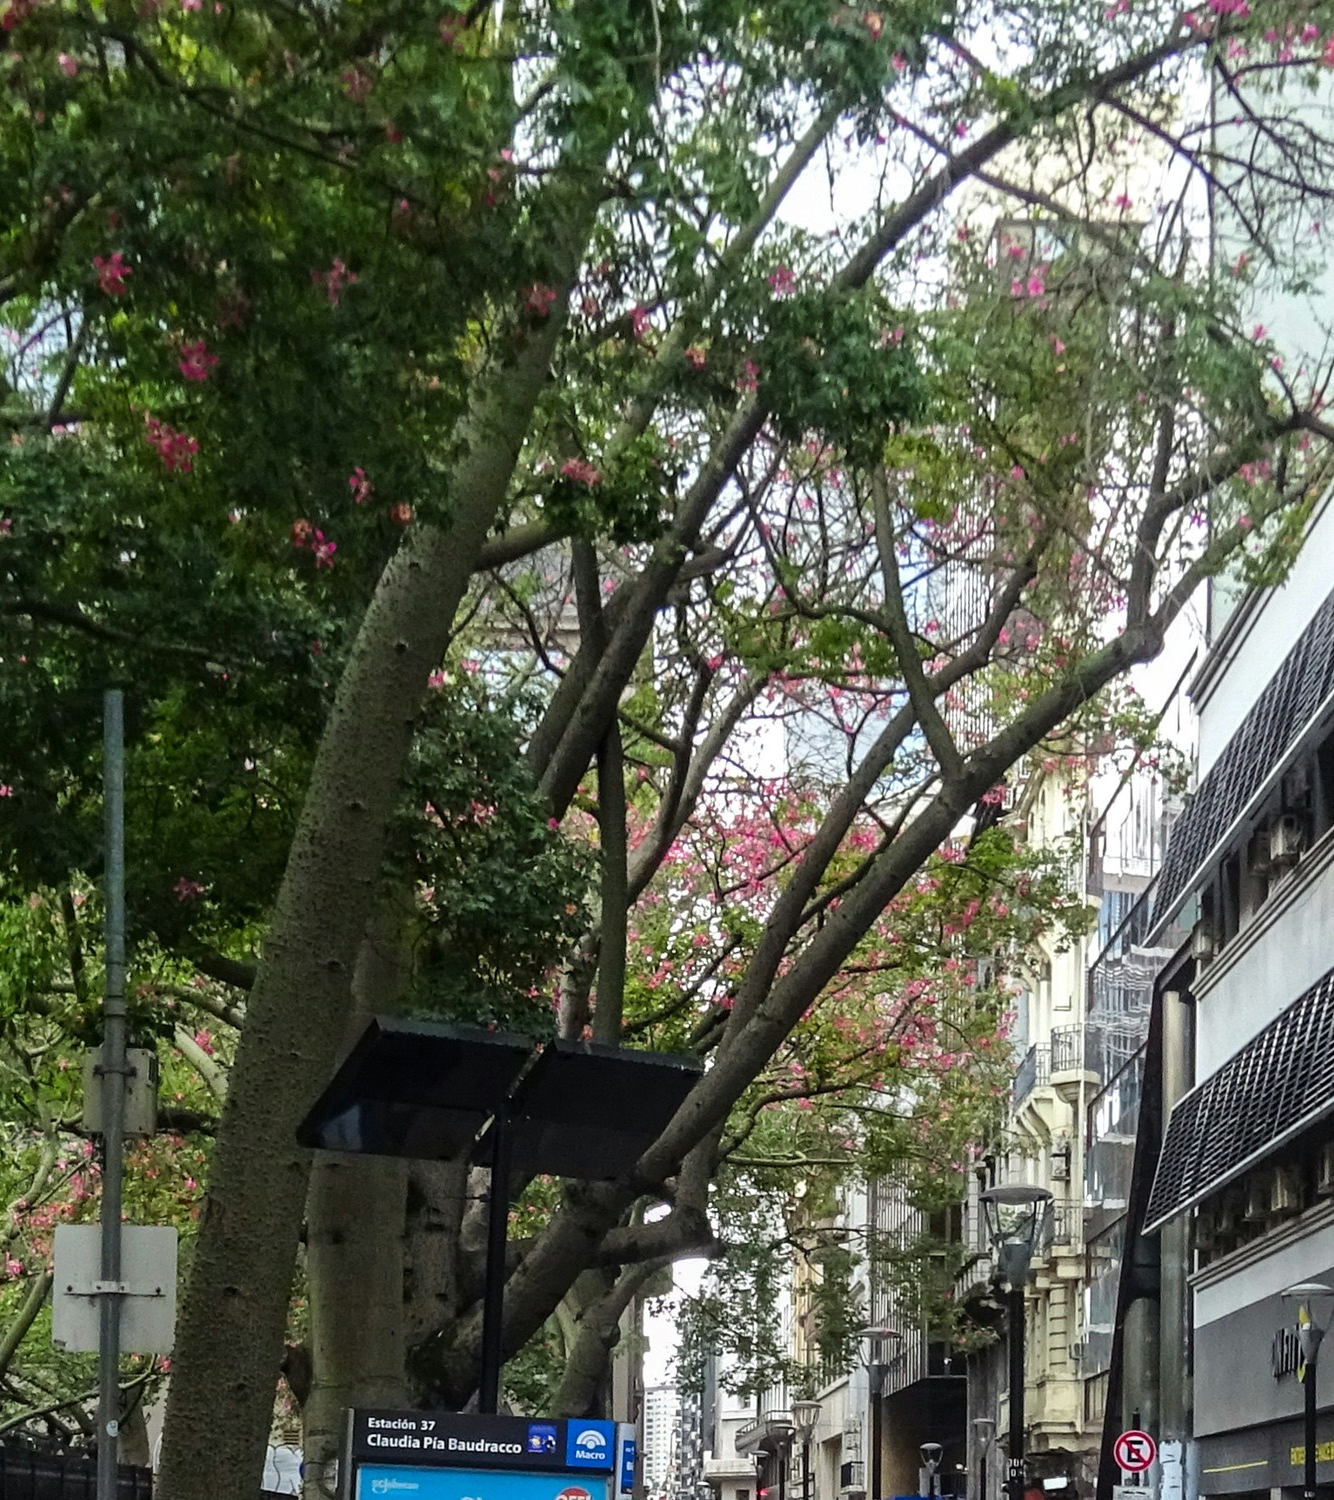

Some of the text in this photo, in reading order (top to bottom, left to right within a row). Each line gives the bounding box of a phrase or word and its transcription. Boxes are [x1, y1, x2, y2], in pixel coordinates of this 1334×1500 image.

[368, 1417, 436, 1431] Estación 37
[367, 1433, 420, 1449] Claudia
[423, 1437, 445, 1450] Pía
[448, 1438, 522, 1454] Baudracco
[575, 1450, 606, 1460] Macro
